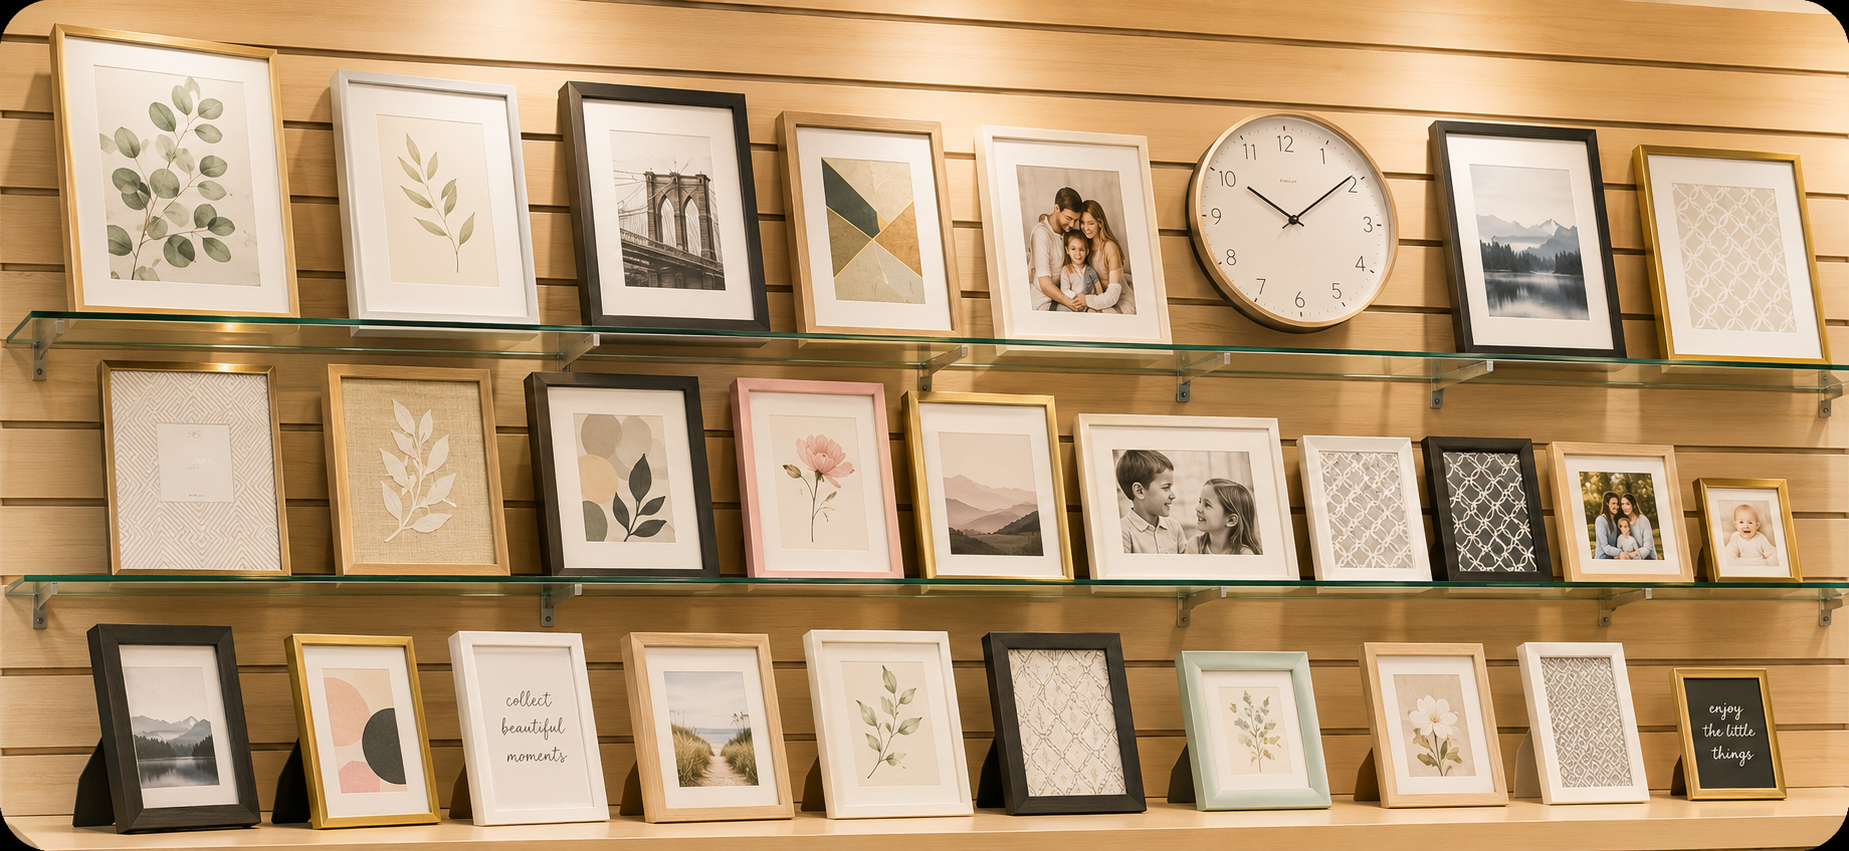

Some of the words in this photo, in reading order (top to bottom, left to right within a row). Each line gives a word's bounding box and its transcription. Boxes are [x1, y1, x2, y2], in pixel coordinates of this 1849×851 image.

[1243, 143, 1257, 160] 11
[1277, 135, 1294, 153] 12
[1320, 148, 1326, 164] 1
[1219, 170, 1237, 187] 10
[1348, 175, 1358, 193] 2
[1211, 208, 1222, 225] 9
[1363, 216, 1374, 233] 3
[1226, 249, 1237, 266] 8
[1355, 256, 1366, 272] 4
[1256, 278, 1267, 295] 7
[1331, 283, 1342, 300] 5
[1295, 291, 1306, 308] 6
[506, 690, 553, 708] collect
[1708, 702, 1744, 721] enjoy
[501, 717, 566, 741] beautiful
[1702, 723, 1724, 738] the
[1726, 723, 1756, 738] little
[506, 746, 568, 763] moments
[1711, 745, 1755, 767] things
